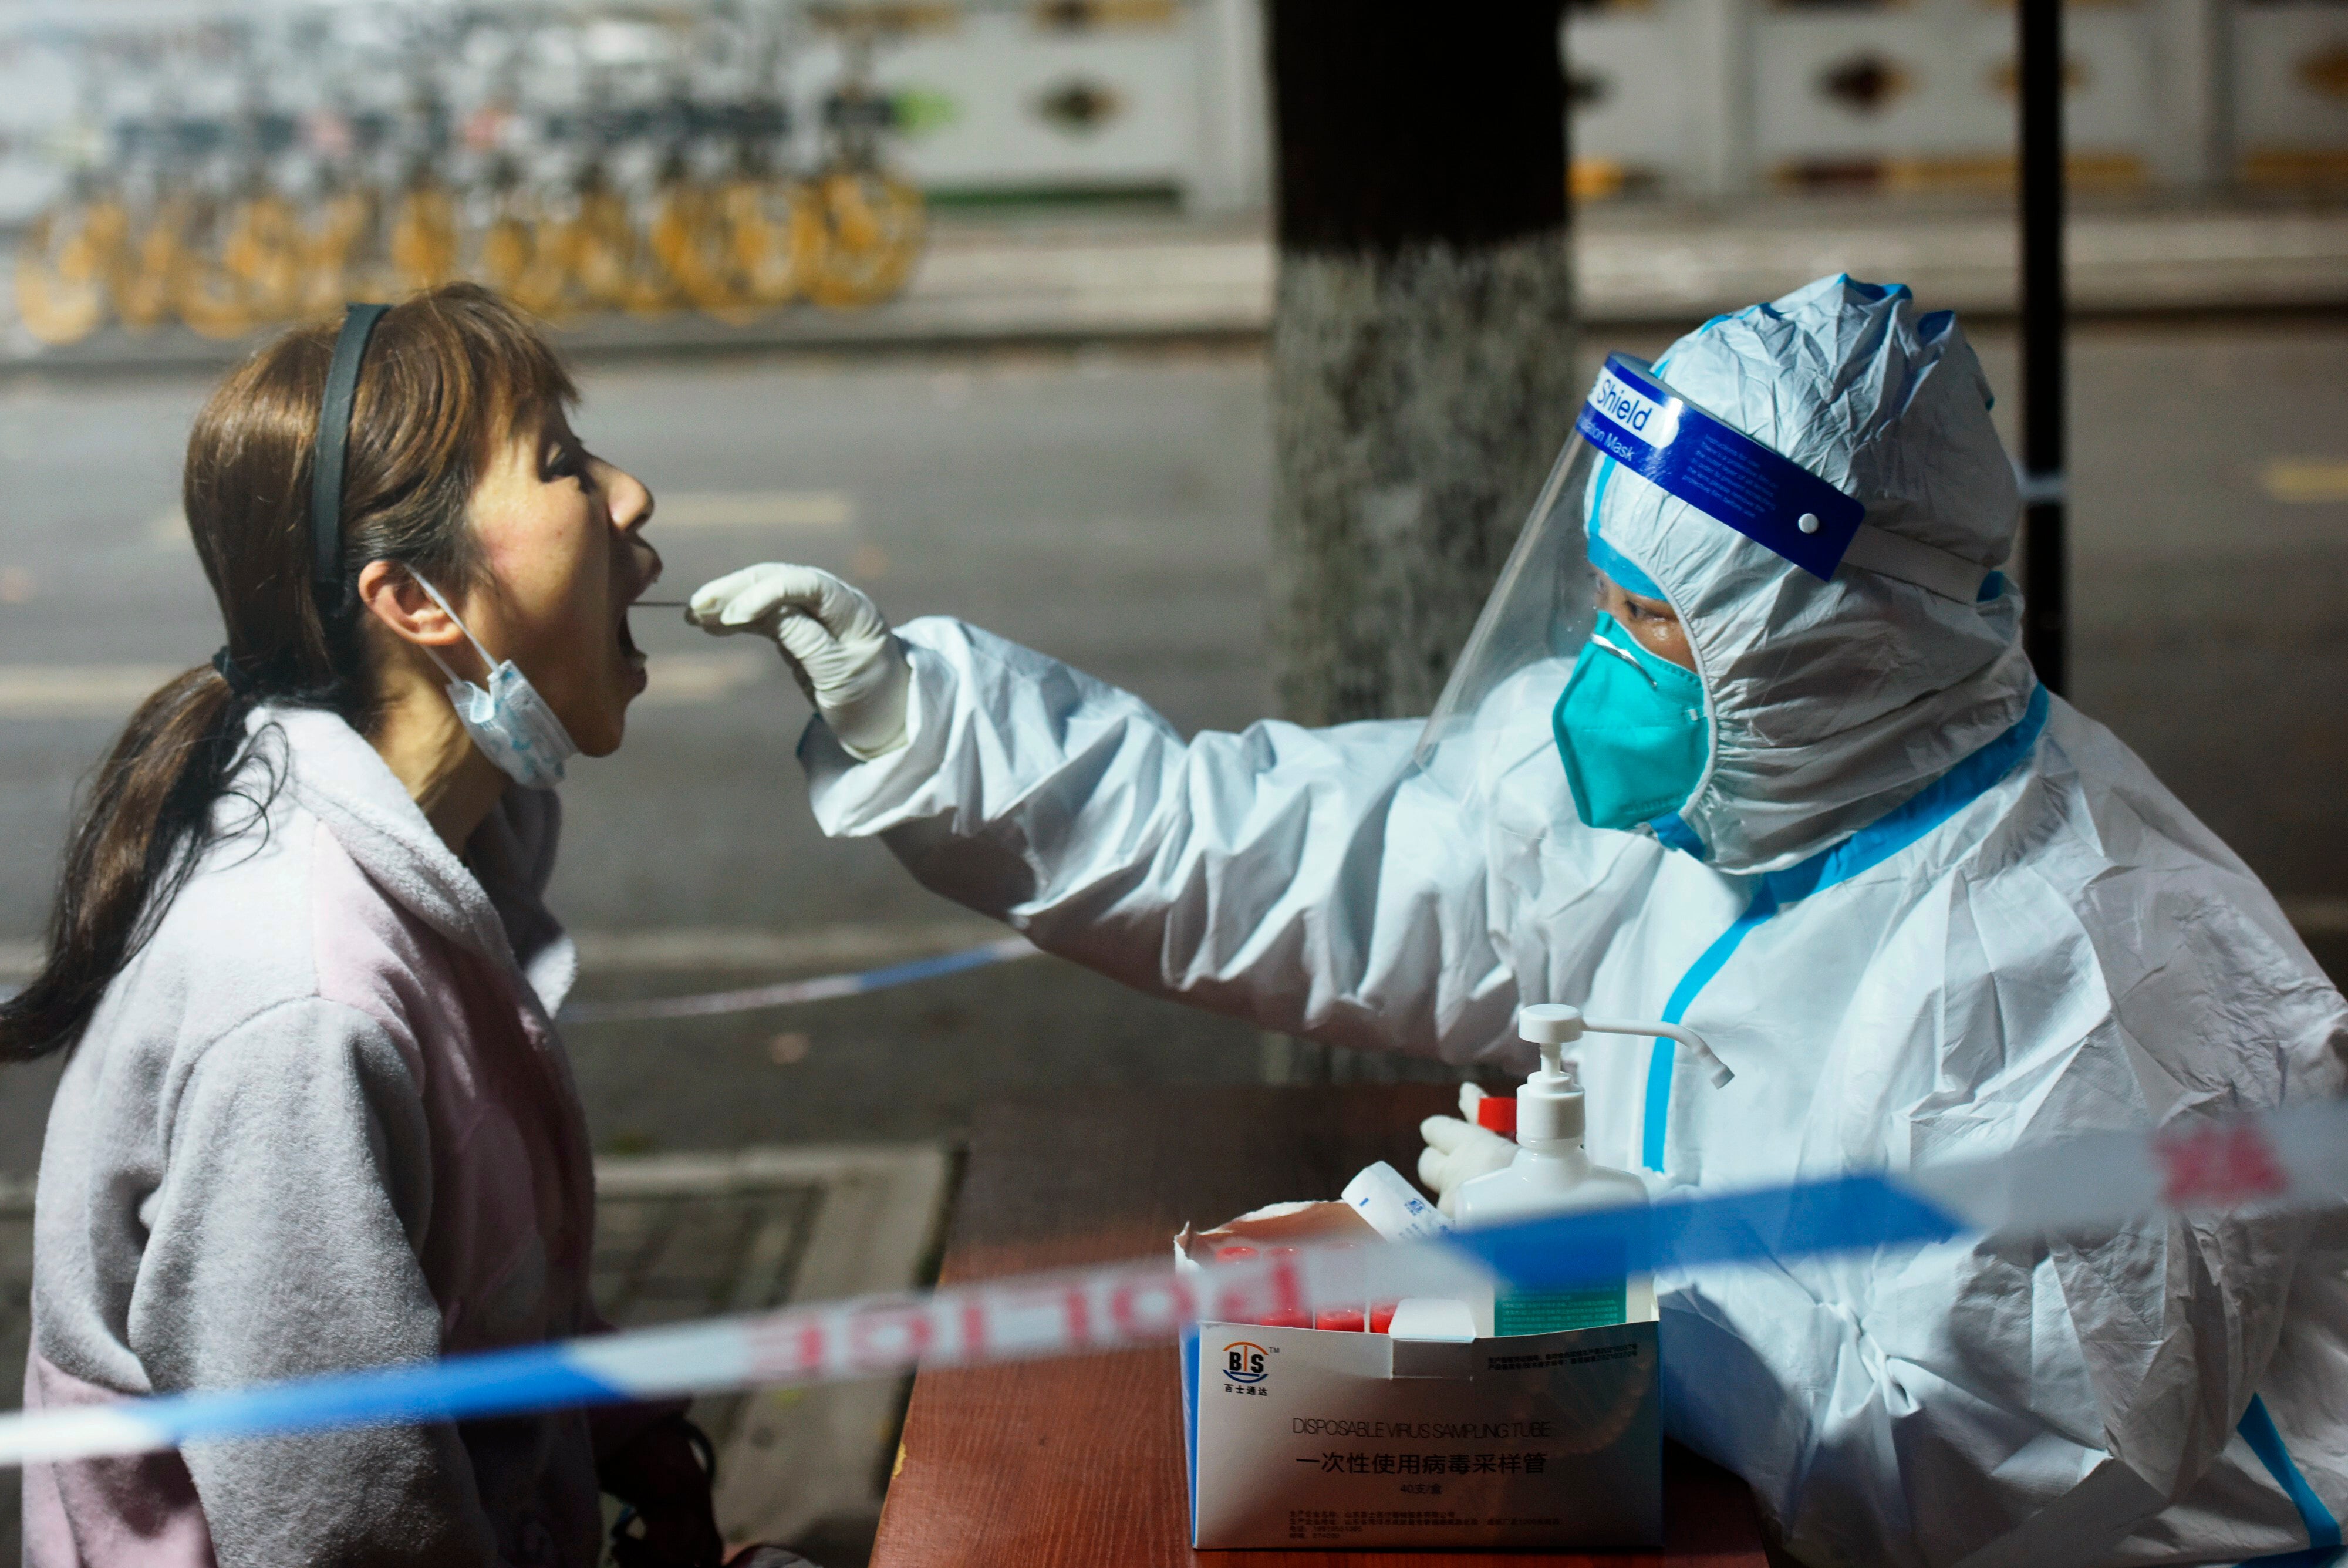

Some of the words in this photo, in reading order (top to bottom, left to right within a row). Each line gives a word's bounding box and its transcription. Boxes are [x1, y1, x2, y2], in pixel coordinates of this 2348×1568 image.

[1597, 379, 1653, 431] Shield
[1604, 433, 1635, 462] Mask
[1224, 1383, 1269, 1397] 百士通达
[1293, 1418, 1385, 1438] DISPOSABLE
[1387, 1421, 1431, 1439] VIRUS
[1433, 1422, 1509, 1439] SAMPLING
[1511, 1421, 1551, 1438] TUBE
[1296, 1451, 1548, 1475] 一次性使用病毒采样管
